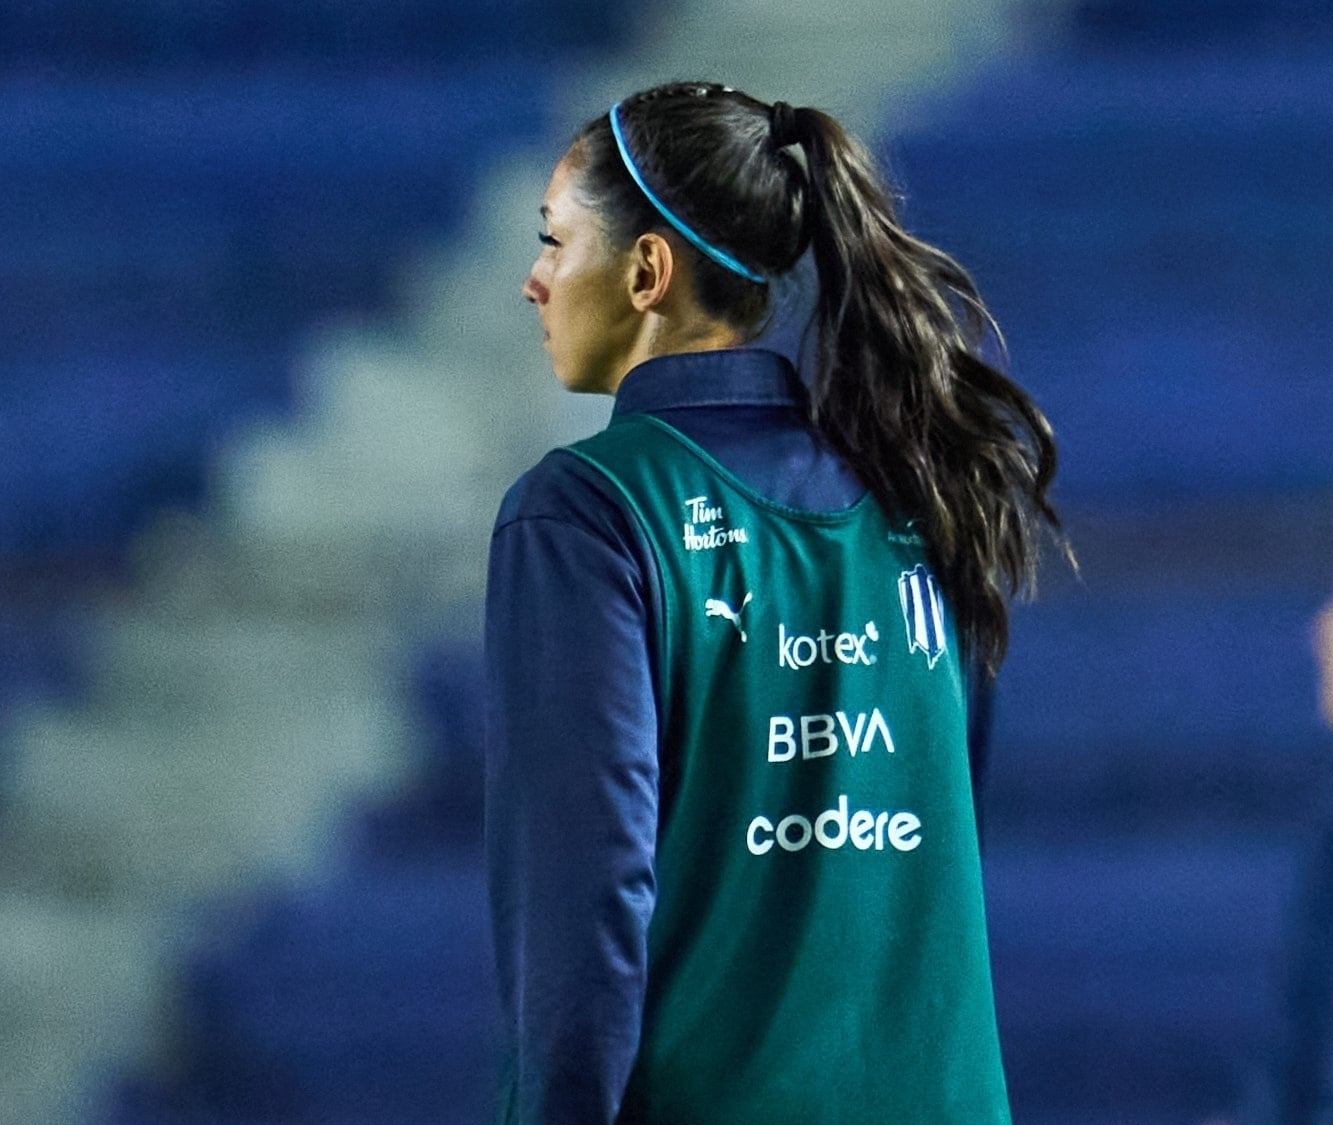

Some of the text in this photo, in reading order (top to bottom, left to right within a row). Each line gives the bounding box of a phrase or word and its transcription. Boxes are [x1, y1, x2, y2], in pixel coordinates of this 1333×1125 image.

[685, 496, 723, 524] Tim
[778, 621, 878, 669] kotex
[767, 708, 894, 762] BBVA
[746, 795, 922, 855] codere
